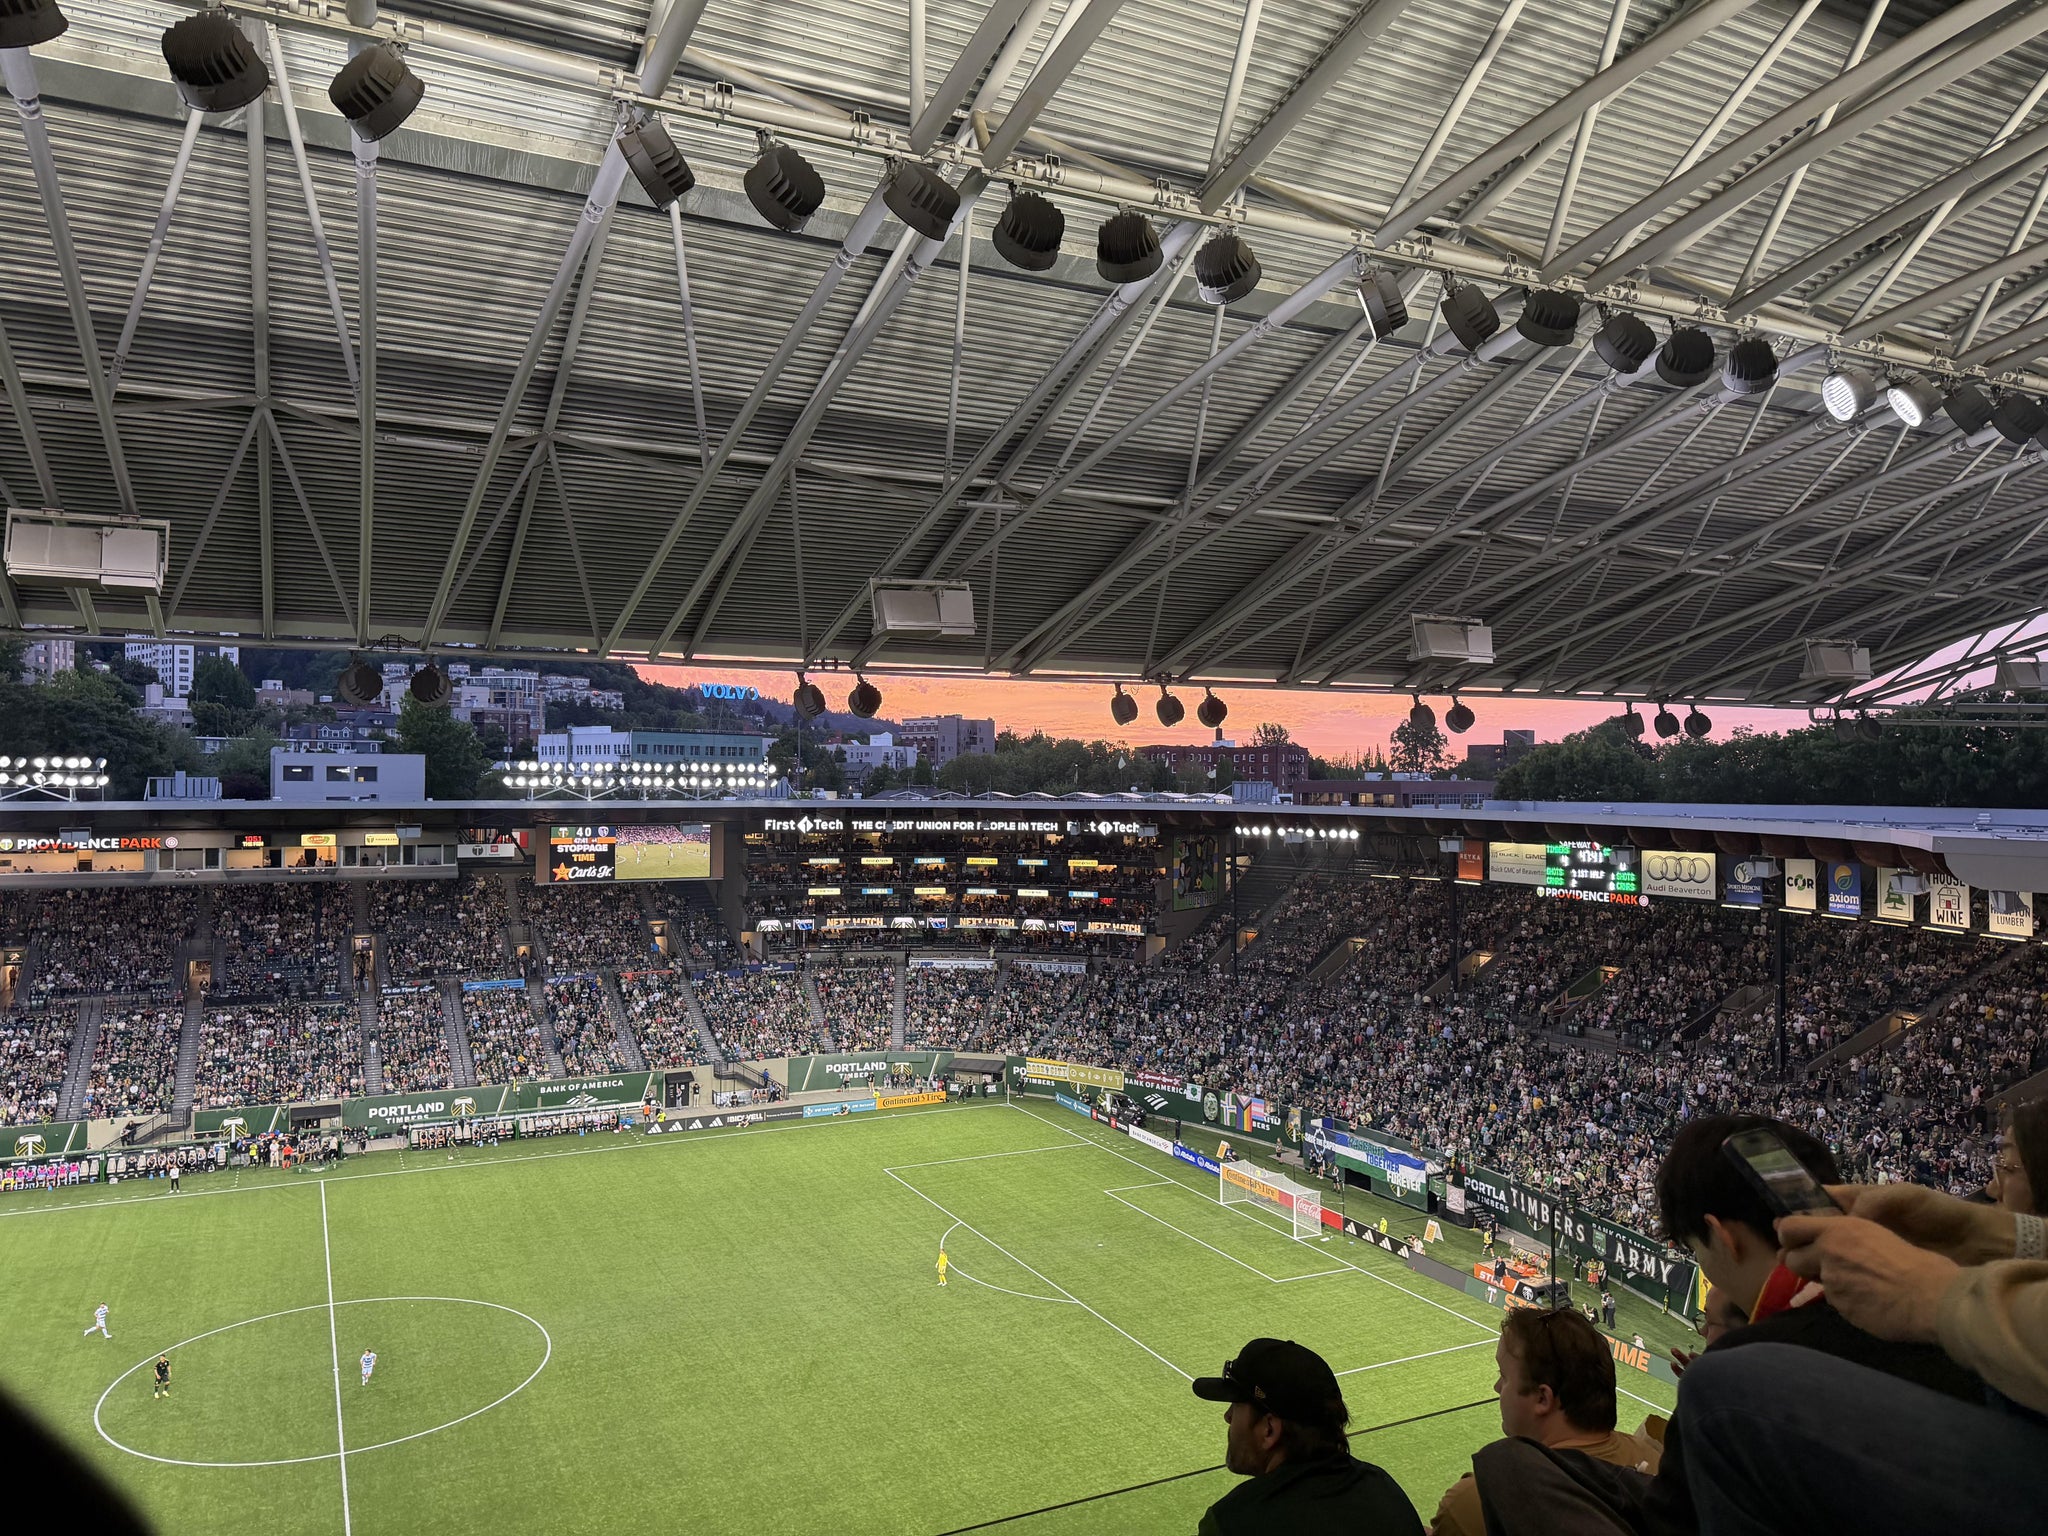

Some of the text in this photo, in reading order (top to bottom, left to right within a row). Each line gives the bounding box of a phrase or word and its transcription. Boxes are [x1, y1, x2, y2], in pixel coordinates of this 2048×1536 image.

[700, 683, 759, 700] VOLVO
[765, 819, 843, 830] First Tech
[852, 821, 873, 830] THE
[916, 821, 951, 830] UNION
[953, 821, 974, 830] FOR
[977, 821, 1016, 831] POPLE
[1018, 821, 1028, 830] IN
[1030, 822, 1058, 831] TECH
[1112, 821, 1140, 833] Tech
[576, 827, 592, 837] 4 0
[557, 844, 609, 852] STOPPAGE
[572, 854, 595, 862] TIME
[569, 866, 597, 878] Carl's
[1491, 865, 1503, 873] Buick
[1646, 884, 1711, 896] Audi Beaverton
[1829, 892, 1859, 904] axiom
[827, 917, 883, 926] NEXT MATCH
[960, 917, 1015, 926] NEXT MATCH
[1936, 909, 1963, 925] WINE
[1997, 915, 2025, 927] LUMBER
[1088, 922, 1141, 933] NEXT MATCH
[826, 1061, 887, 1073] PORTLAND
[540, 1079, 624, 1094] BANK OF AMERICA
[1125, 1078, 1144, 1087] BANK
[1145, 1081, 1155, 1089] OF
[1156, 1083, 1187, 1095] AMERICA
[882, 1093, 941, 1107] Continental Tire
[368, 1102, 445, 1119] PORTLAND
[1366, 1153, 1400, 1174] TOGETHER
[1387, 1170, 1421, 1193] FOREVER
[1464, 1175, 1506, 1204] PORTLA
[1477, 1194, 1509, 1214] TIMBERS
[1510, 1187, 1585, 1243] TIMBERS
[1615, 1242, 1675, 1285] ARMY
[1604, 1334, 1650, 1373] TIME
